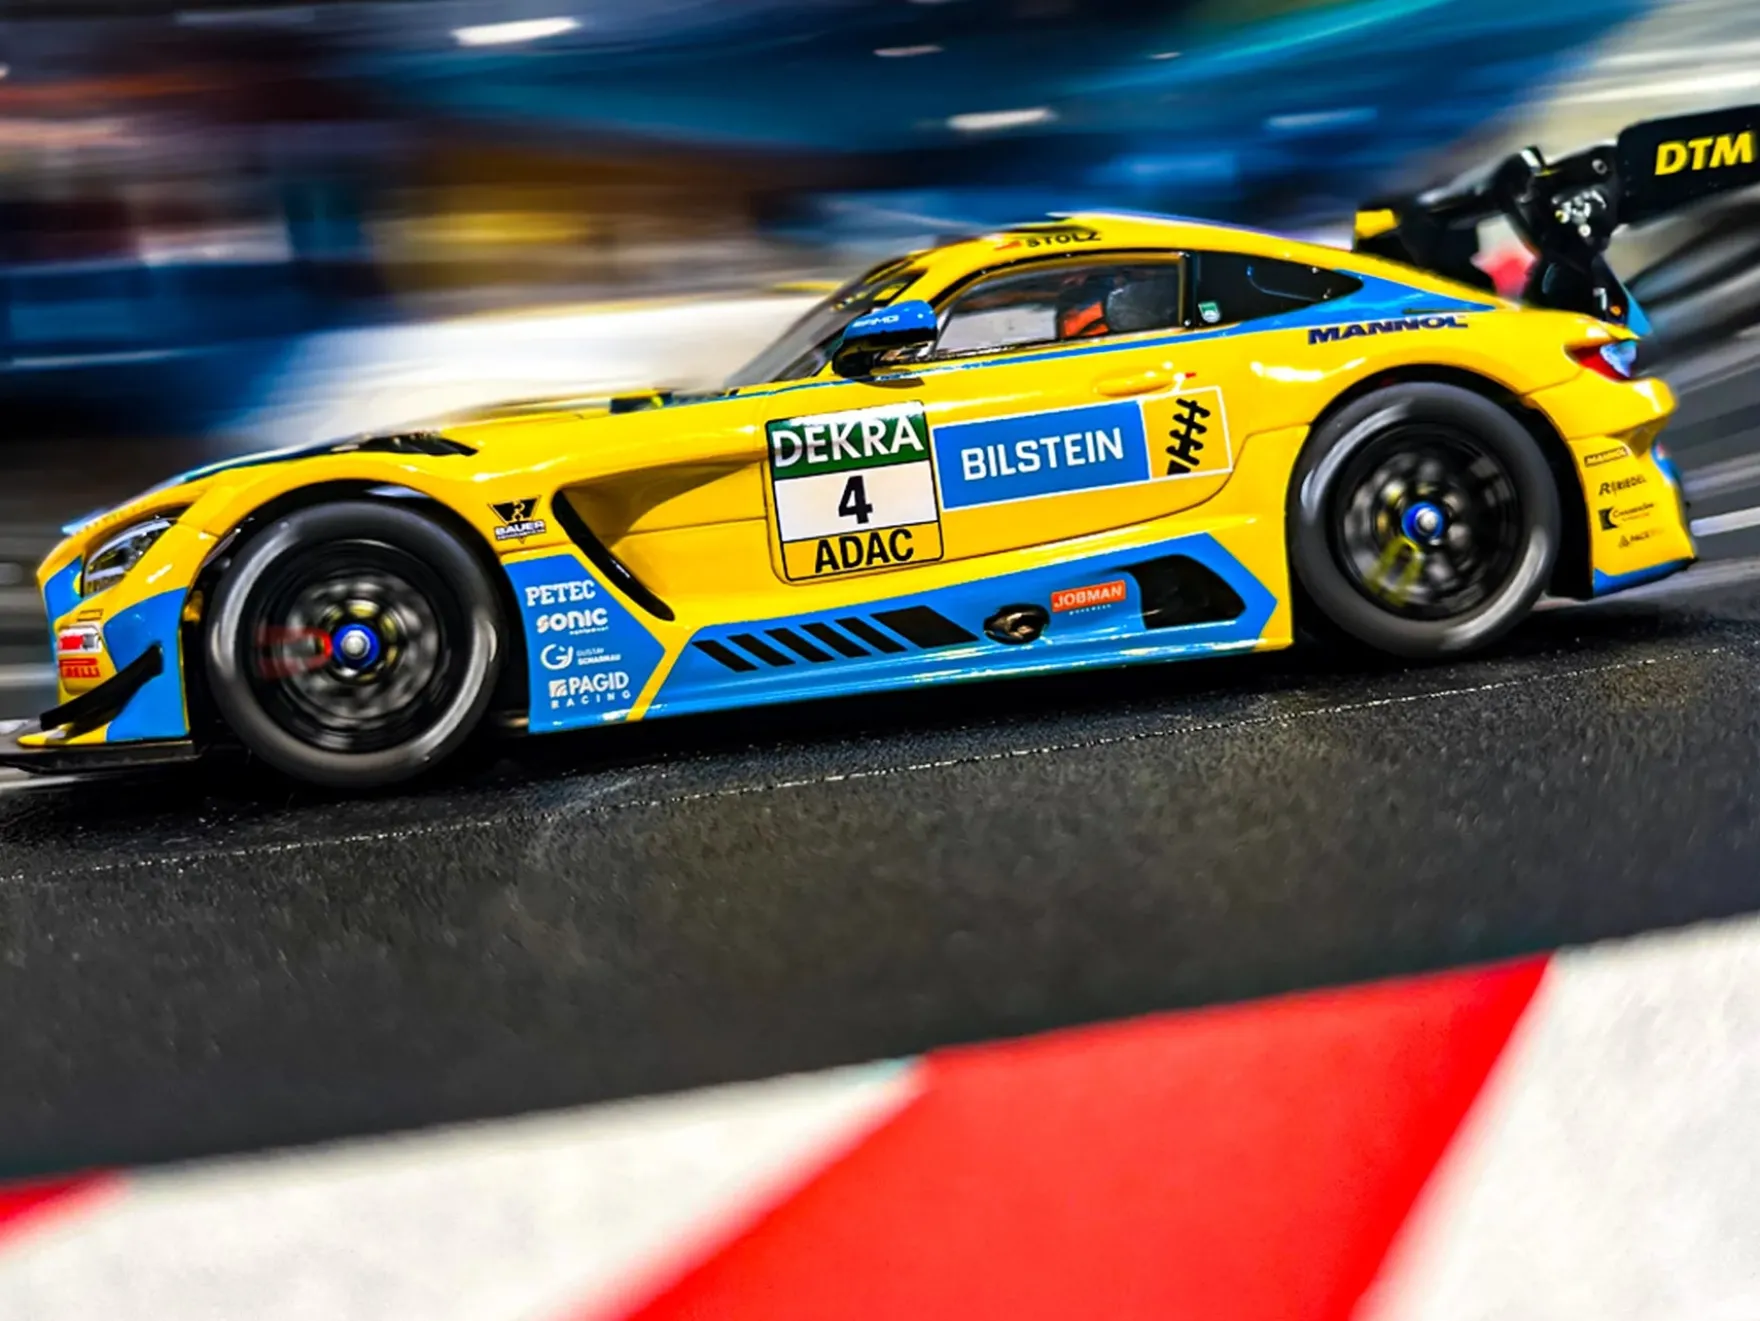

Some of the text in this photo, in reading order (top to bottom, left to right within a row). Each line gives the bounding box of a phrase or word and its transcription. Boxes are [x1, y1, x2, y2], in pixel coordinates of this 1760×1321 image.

[1654, 130, 1754, 175] DTM
[1026, 230, 1101, 248] STOLZ
[1308, 315, 1468, 346] MANNOL
[772, 416, 924, 468] DEKRA
[960, 428, 1125, 481] BILSTEIN
[837, 475, 874, 525] 4
[495, 520, 546, 535] BAUER
[814, 528, 914, 574] ADAC
[525, 579, 596, 607] PETEC
[1054, 584, 1122, 608] JOBMAN
[536, 607, 609, 633] sonic
[568, 671, 630, 696] PAGID
[551, 690, 632, 710] RACING
